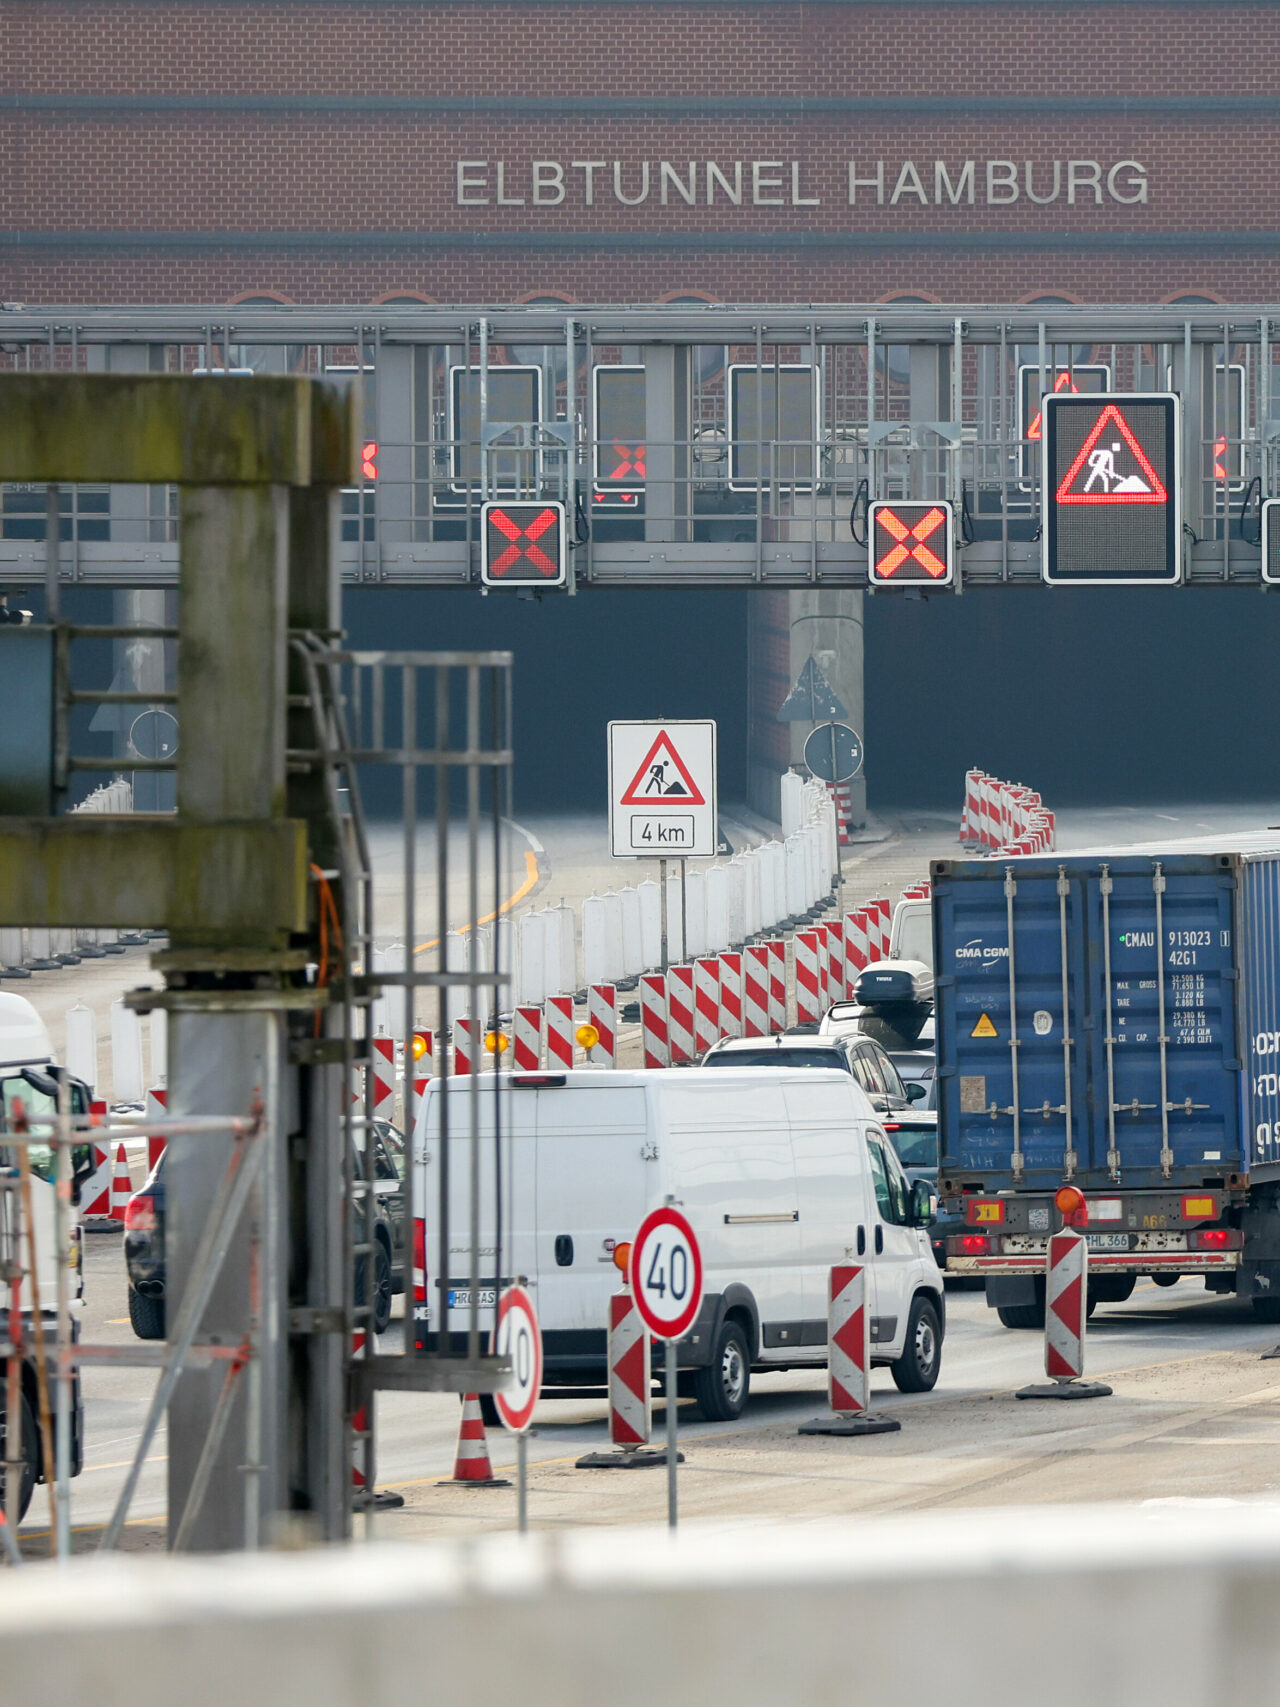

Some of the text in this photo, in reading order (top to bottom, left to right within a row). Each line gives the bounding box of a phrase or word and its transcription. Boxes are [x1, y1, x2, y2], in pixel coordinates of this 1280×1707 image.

[456, 160, 1148, 205] ELBTUNNEL HAMBURG
[641, 822, 685, 842] 4 km
[1125, 931, 1154, 947] CMAU
[1168, 931, 1211, 946] 913023
[955, 947, 1009, 958] CMA CGM
[1168, 950, 1197, 965] 42G1
[1139, 980, 1156, 989] GROSS
[1196, 982, 1204, 990] LB
[1196, 991, 1204, 999] KG
[1117, 998, 1130, 1007] TARE
[1197, 1011, 1206, 1019] KG
[1090, 1234, 1127, 1247] HL 366
[646, 1242, 687, 1301] 40
